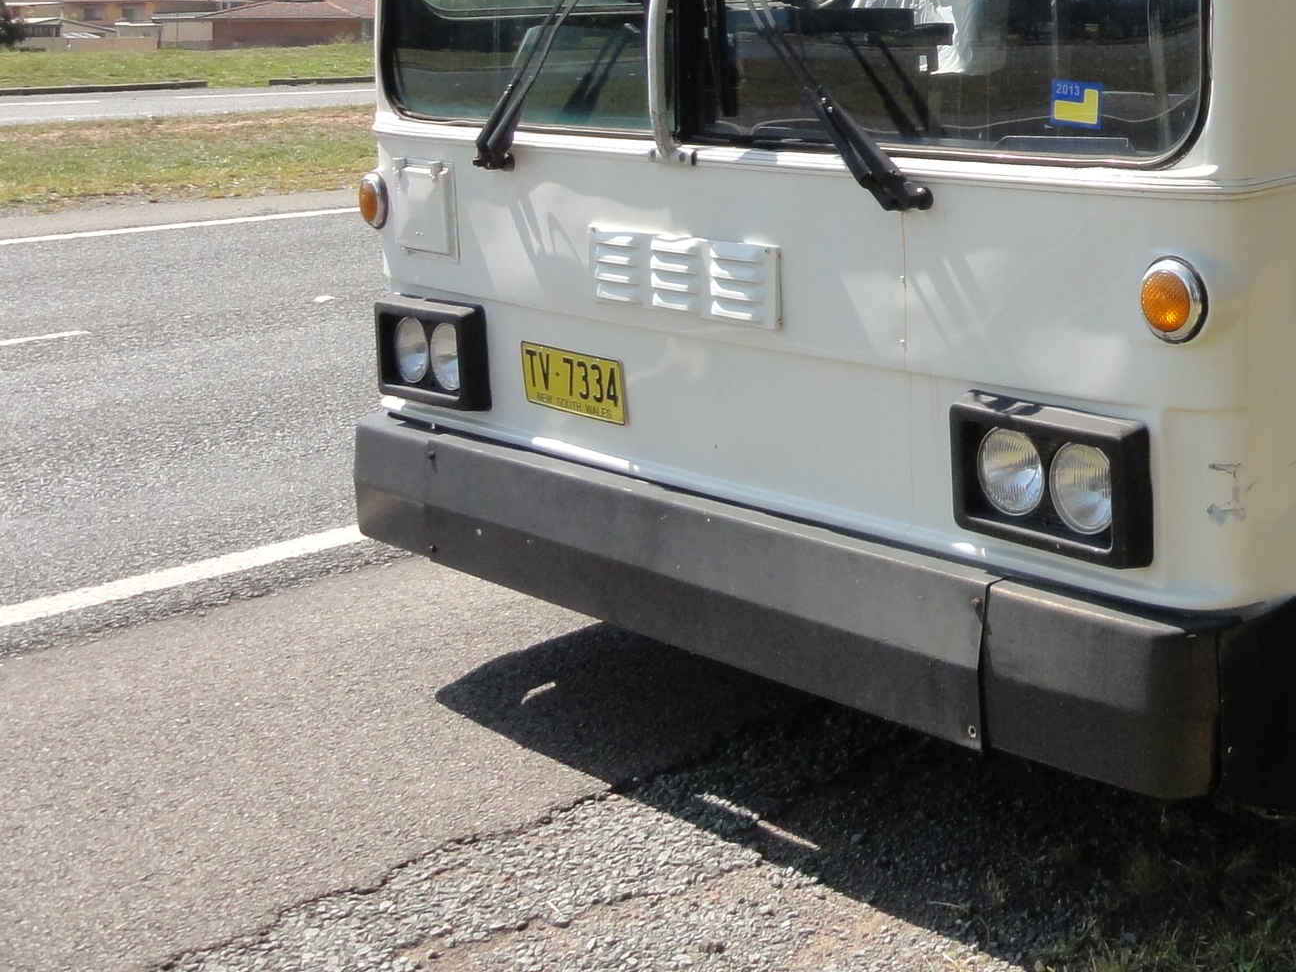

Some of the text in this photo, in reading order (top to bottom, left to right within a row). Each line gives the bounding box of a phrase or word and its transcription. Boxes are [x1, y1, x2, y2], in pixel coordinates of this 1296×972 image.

[1056, 83, 1080, 96] 2013
[537, 392, 612, 419] NEW SOUTH WALES
